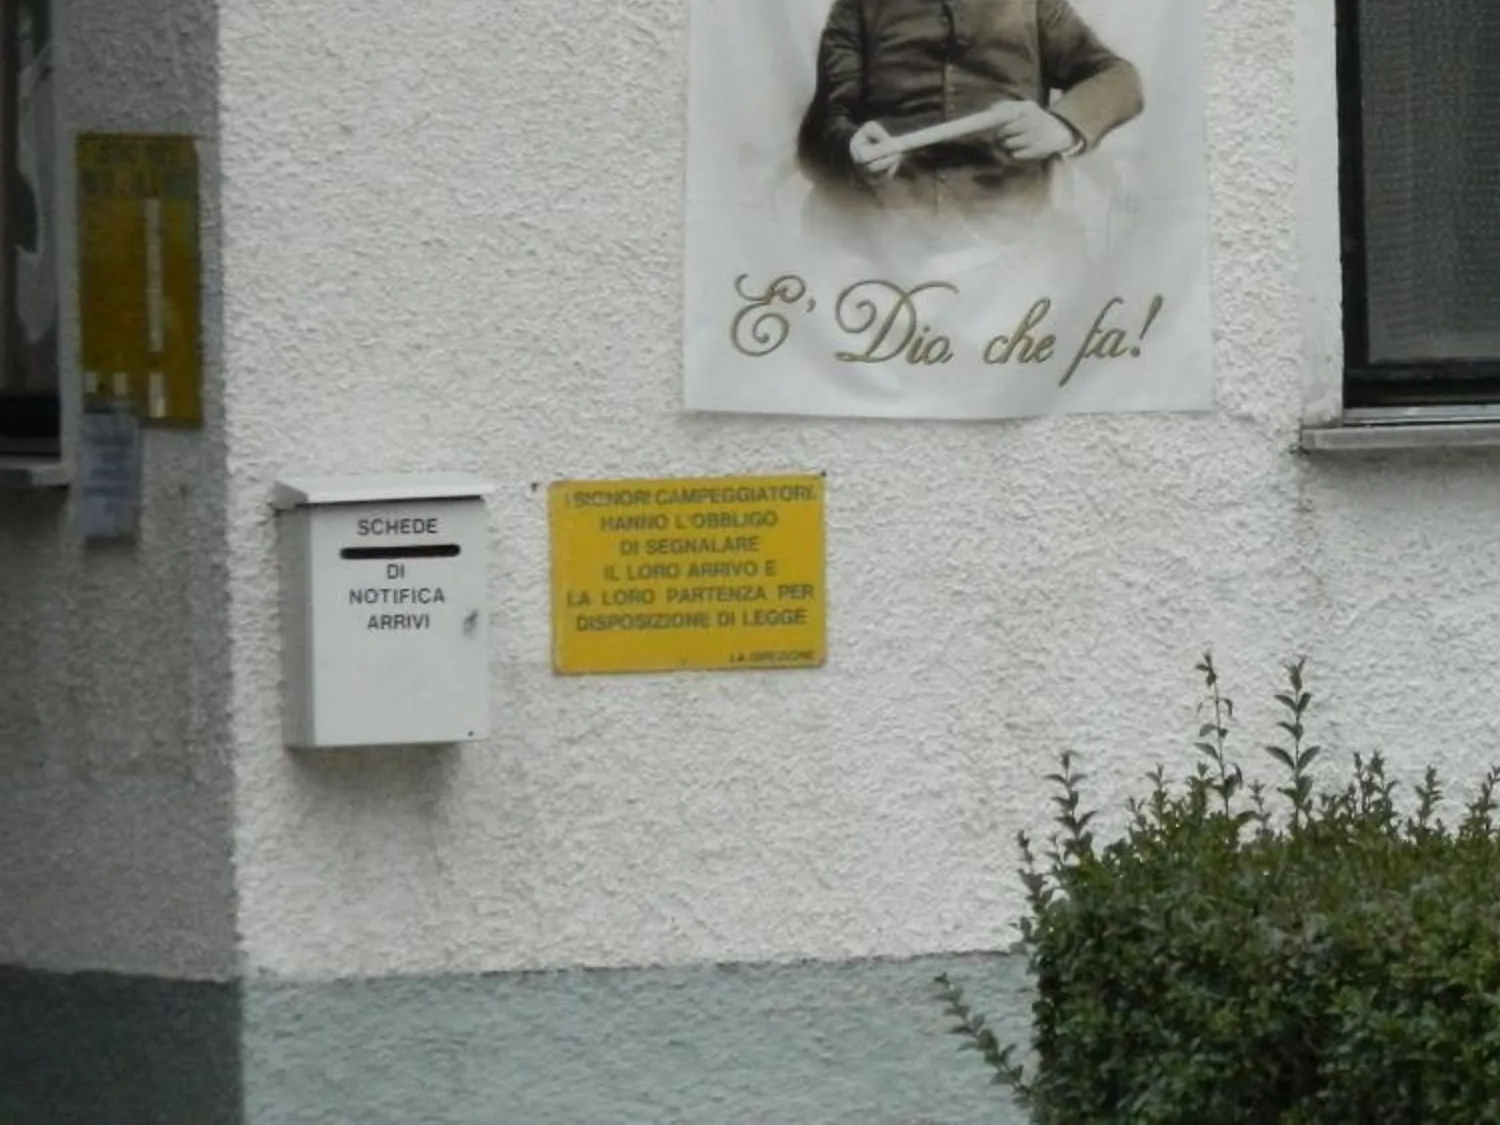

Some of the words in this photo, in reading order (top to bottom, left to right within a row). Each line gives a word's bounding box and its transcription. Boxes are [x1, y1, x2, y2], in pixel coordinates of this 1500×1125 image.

[834, 280, 959, 366] Dio
[982, 299, 1054, 366] che
[1058, 294, 1164, 388] fa!
[655, 484, 815, 506] CAMPEGGIATORI
[357, 518, 438, 536] SCHEDE
[600, 514, 668, 532] HANNO
[620, 541, 639, 556] DI
[645, 537, 760, 556] SEGNALARE
[387, 564, 405, 580] DI
[604, 566, 620, 581] IL
[627, 563, 680, 580] LORO
[687, 562, 757, 578] ARRIVO
[765, 560, 777, 575] E
[349, 588, 445, 604] NOTIFICA
[566, 590, 591, 607] LA
[602, 588, 655, 606] LORO
[667, 586, 766, 604] PARTENZA
[778, 584, 814, 600] PER
[367, 614, 430, 630] ARRIVI
[576, 613, 709, 631] DISPOSIZIONE
[717, 611, 735, 627] DI
[742, 608, 808, 626] LEGGE
